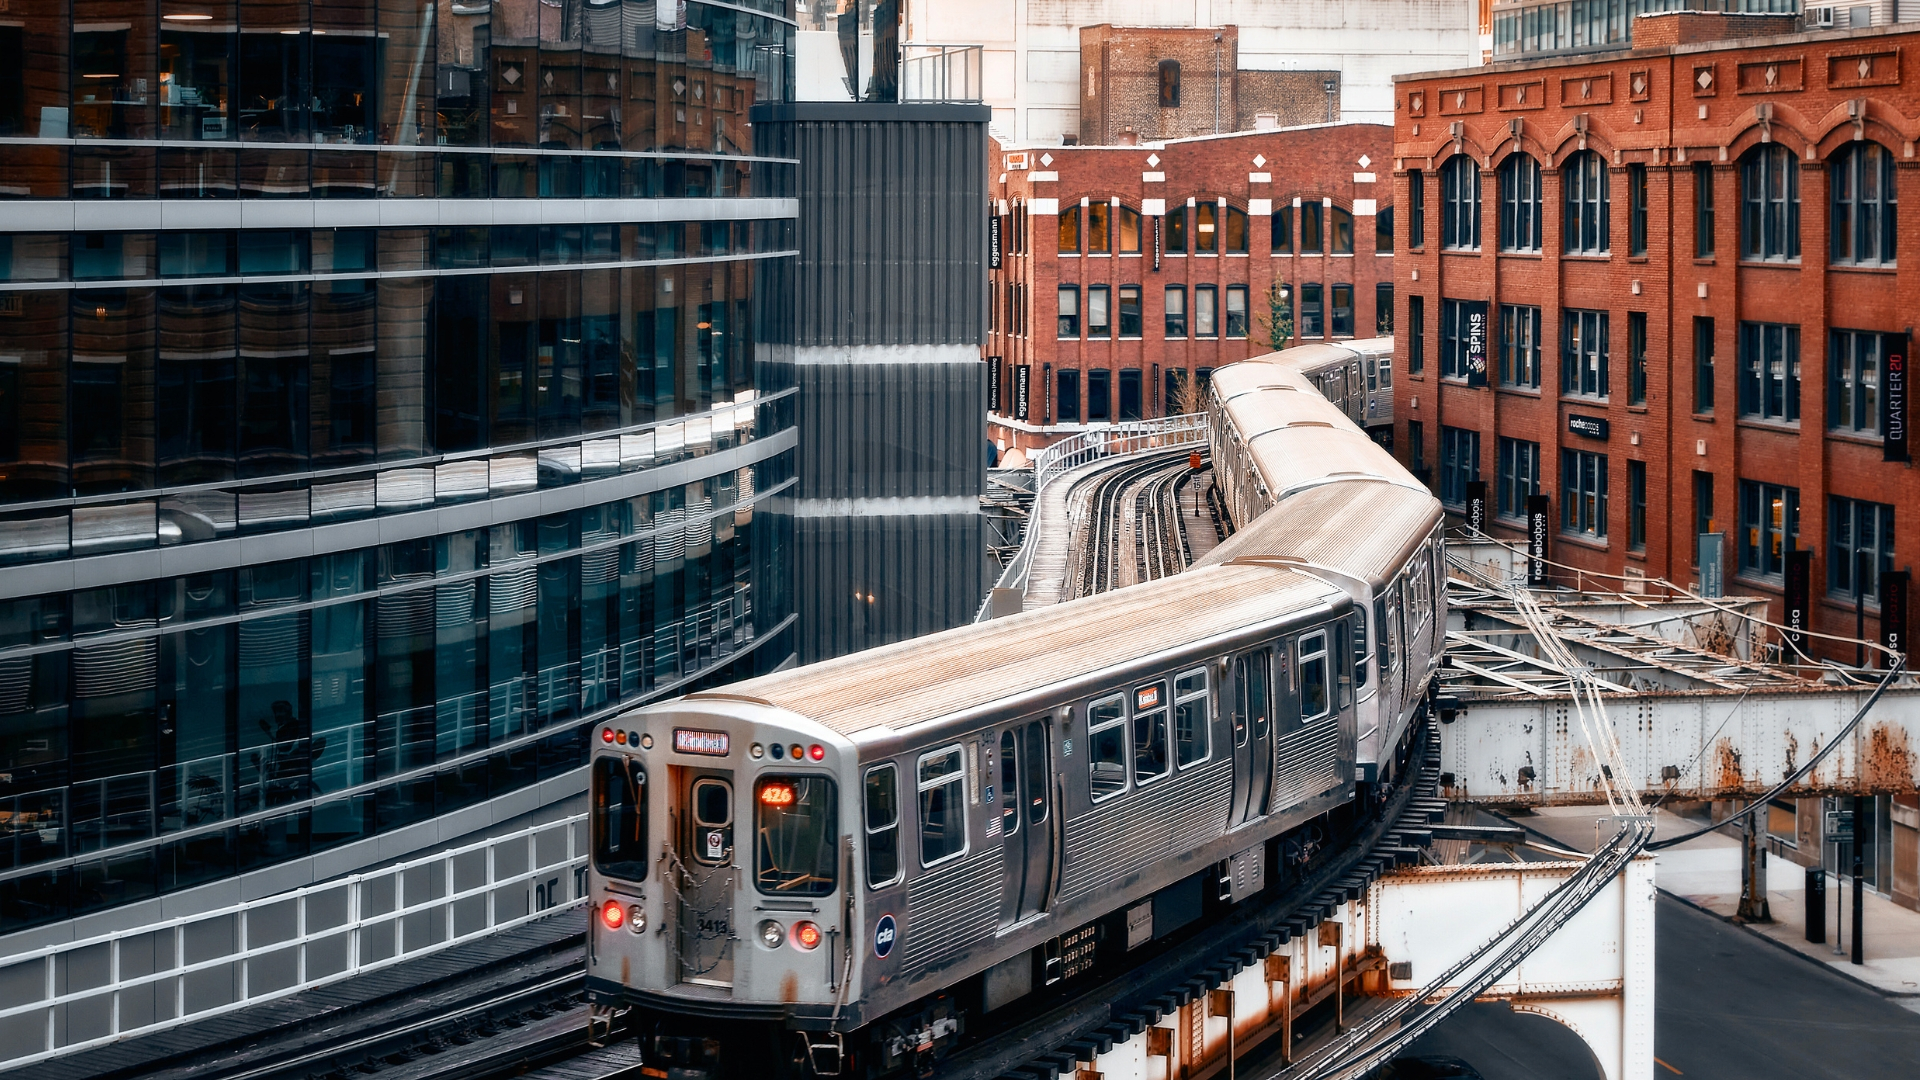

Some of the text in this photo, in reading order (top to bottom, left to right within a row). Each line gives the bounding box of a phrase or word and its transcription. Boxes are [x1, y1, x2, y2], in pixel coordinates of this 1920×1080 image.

[1470, 313, 1481, 354] SPINS
[1019, 367, 1027, 417] eggersmann
[1889, 354, 1903, 440] QUARTER20
[761, 787, 792, 803] 426
[697, 918, 728, 934] 3413
[877, 927, 894, 945] cta
